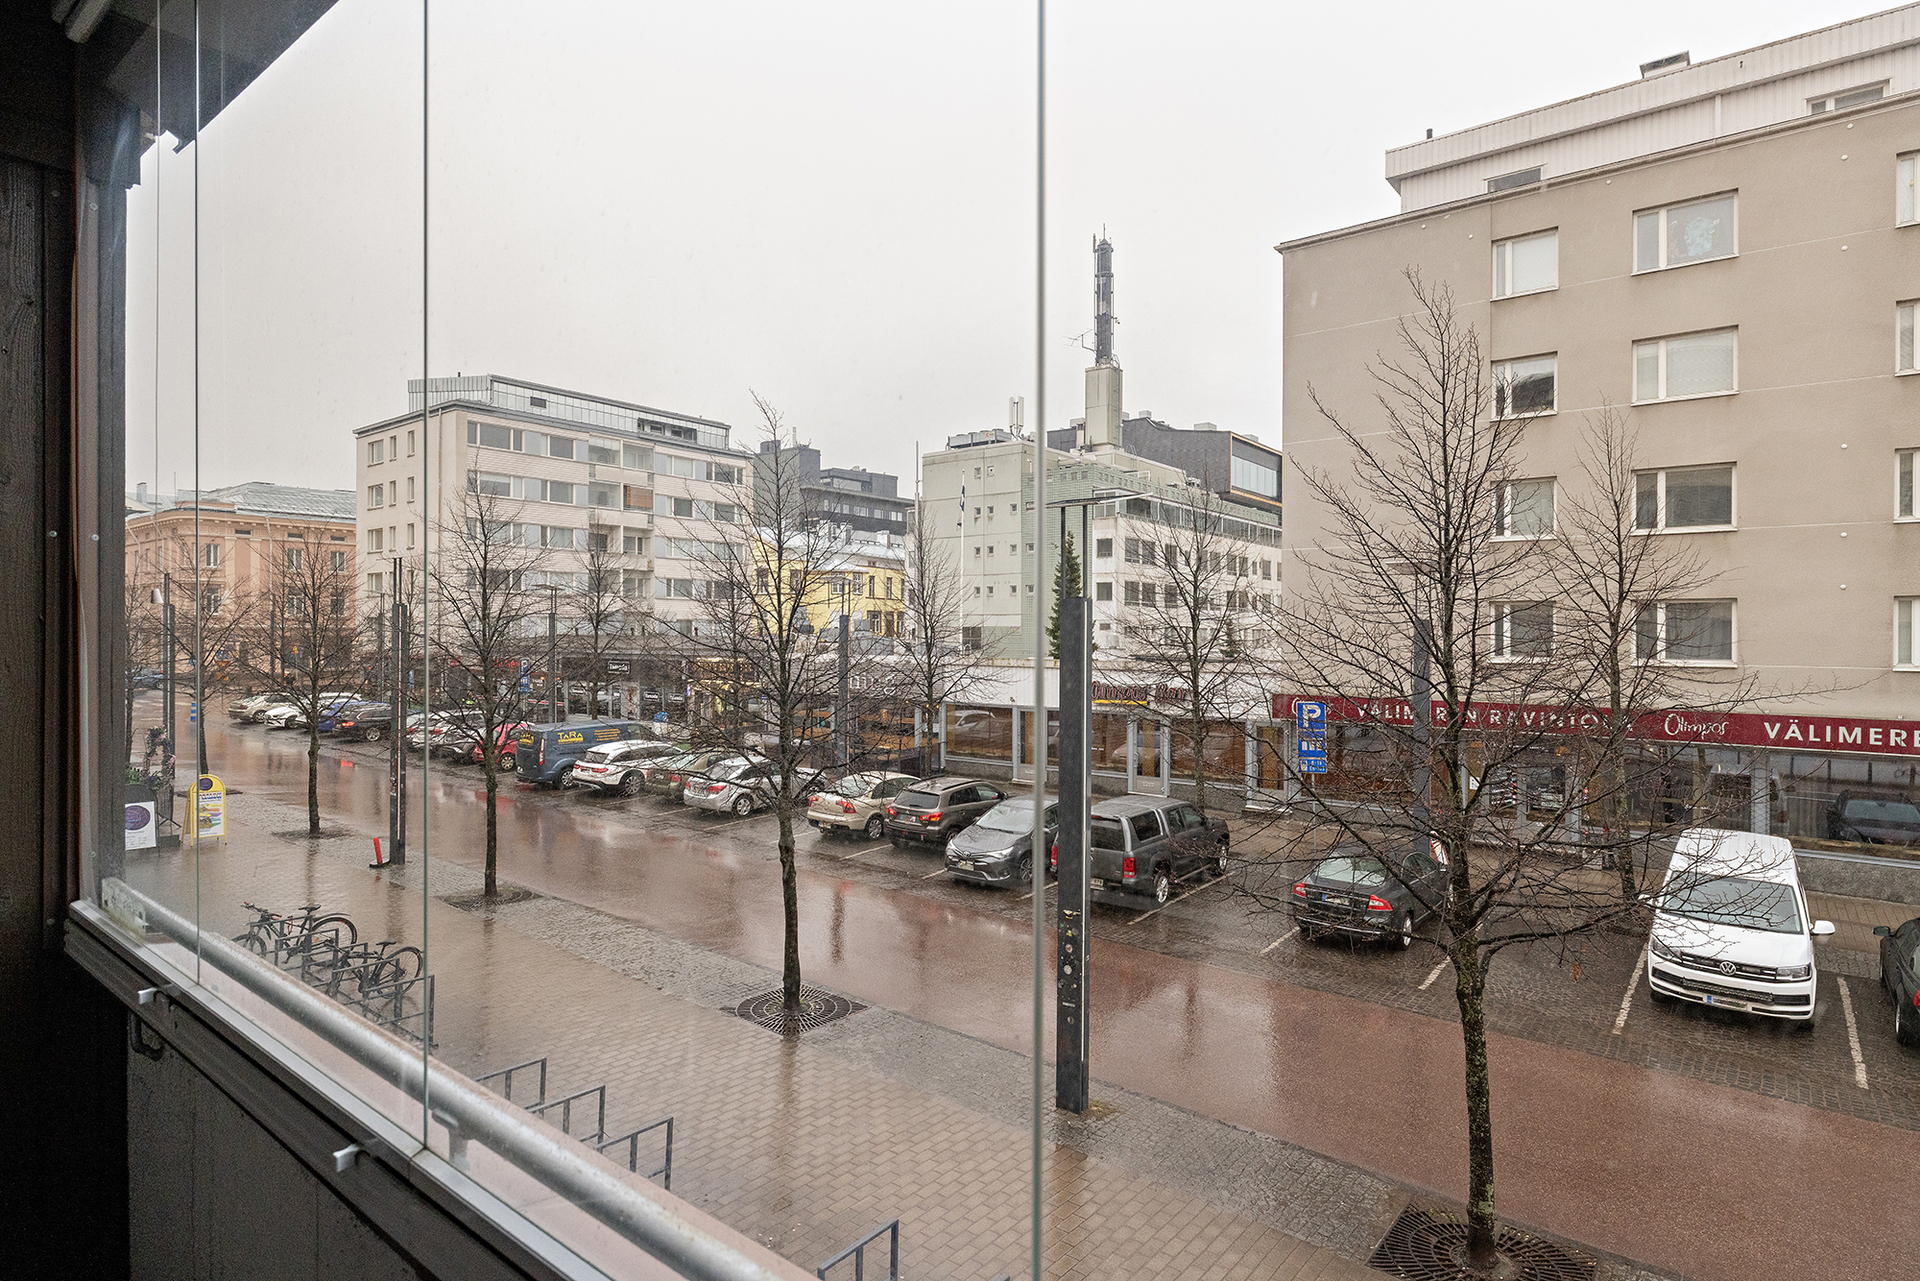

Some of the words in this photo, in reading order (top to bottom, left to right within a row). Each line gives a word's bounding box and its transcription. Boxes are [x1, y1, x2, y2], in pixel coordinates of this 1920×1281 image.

[1302, 704, 1322, 728] P
[1356, 701, 1477, 724] VÄLIMRN
[1664, 713, 1730, 740] Olimpos
